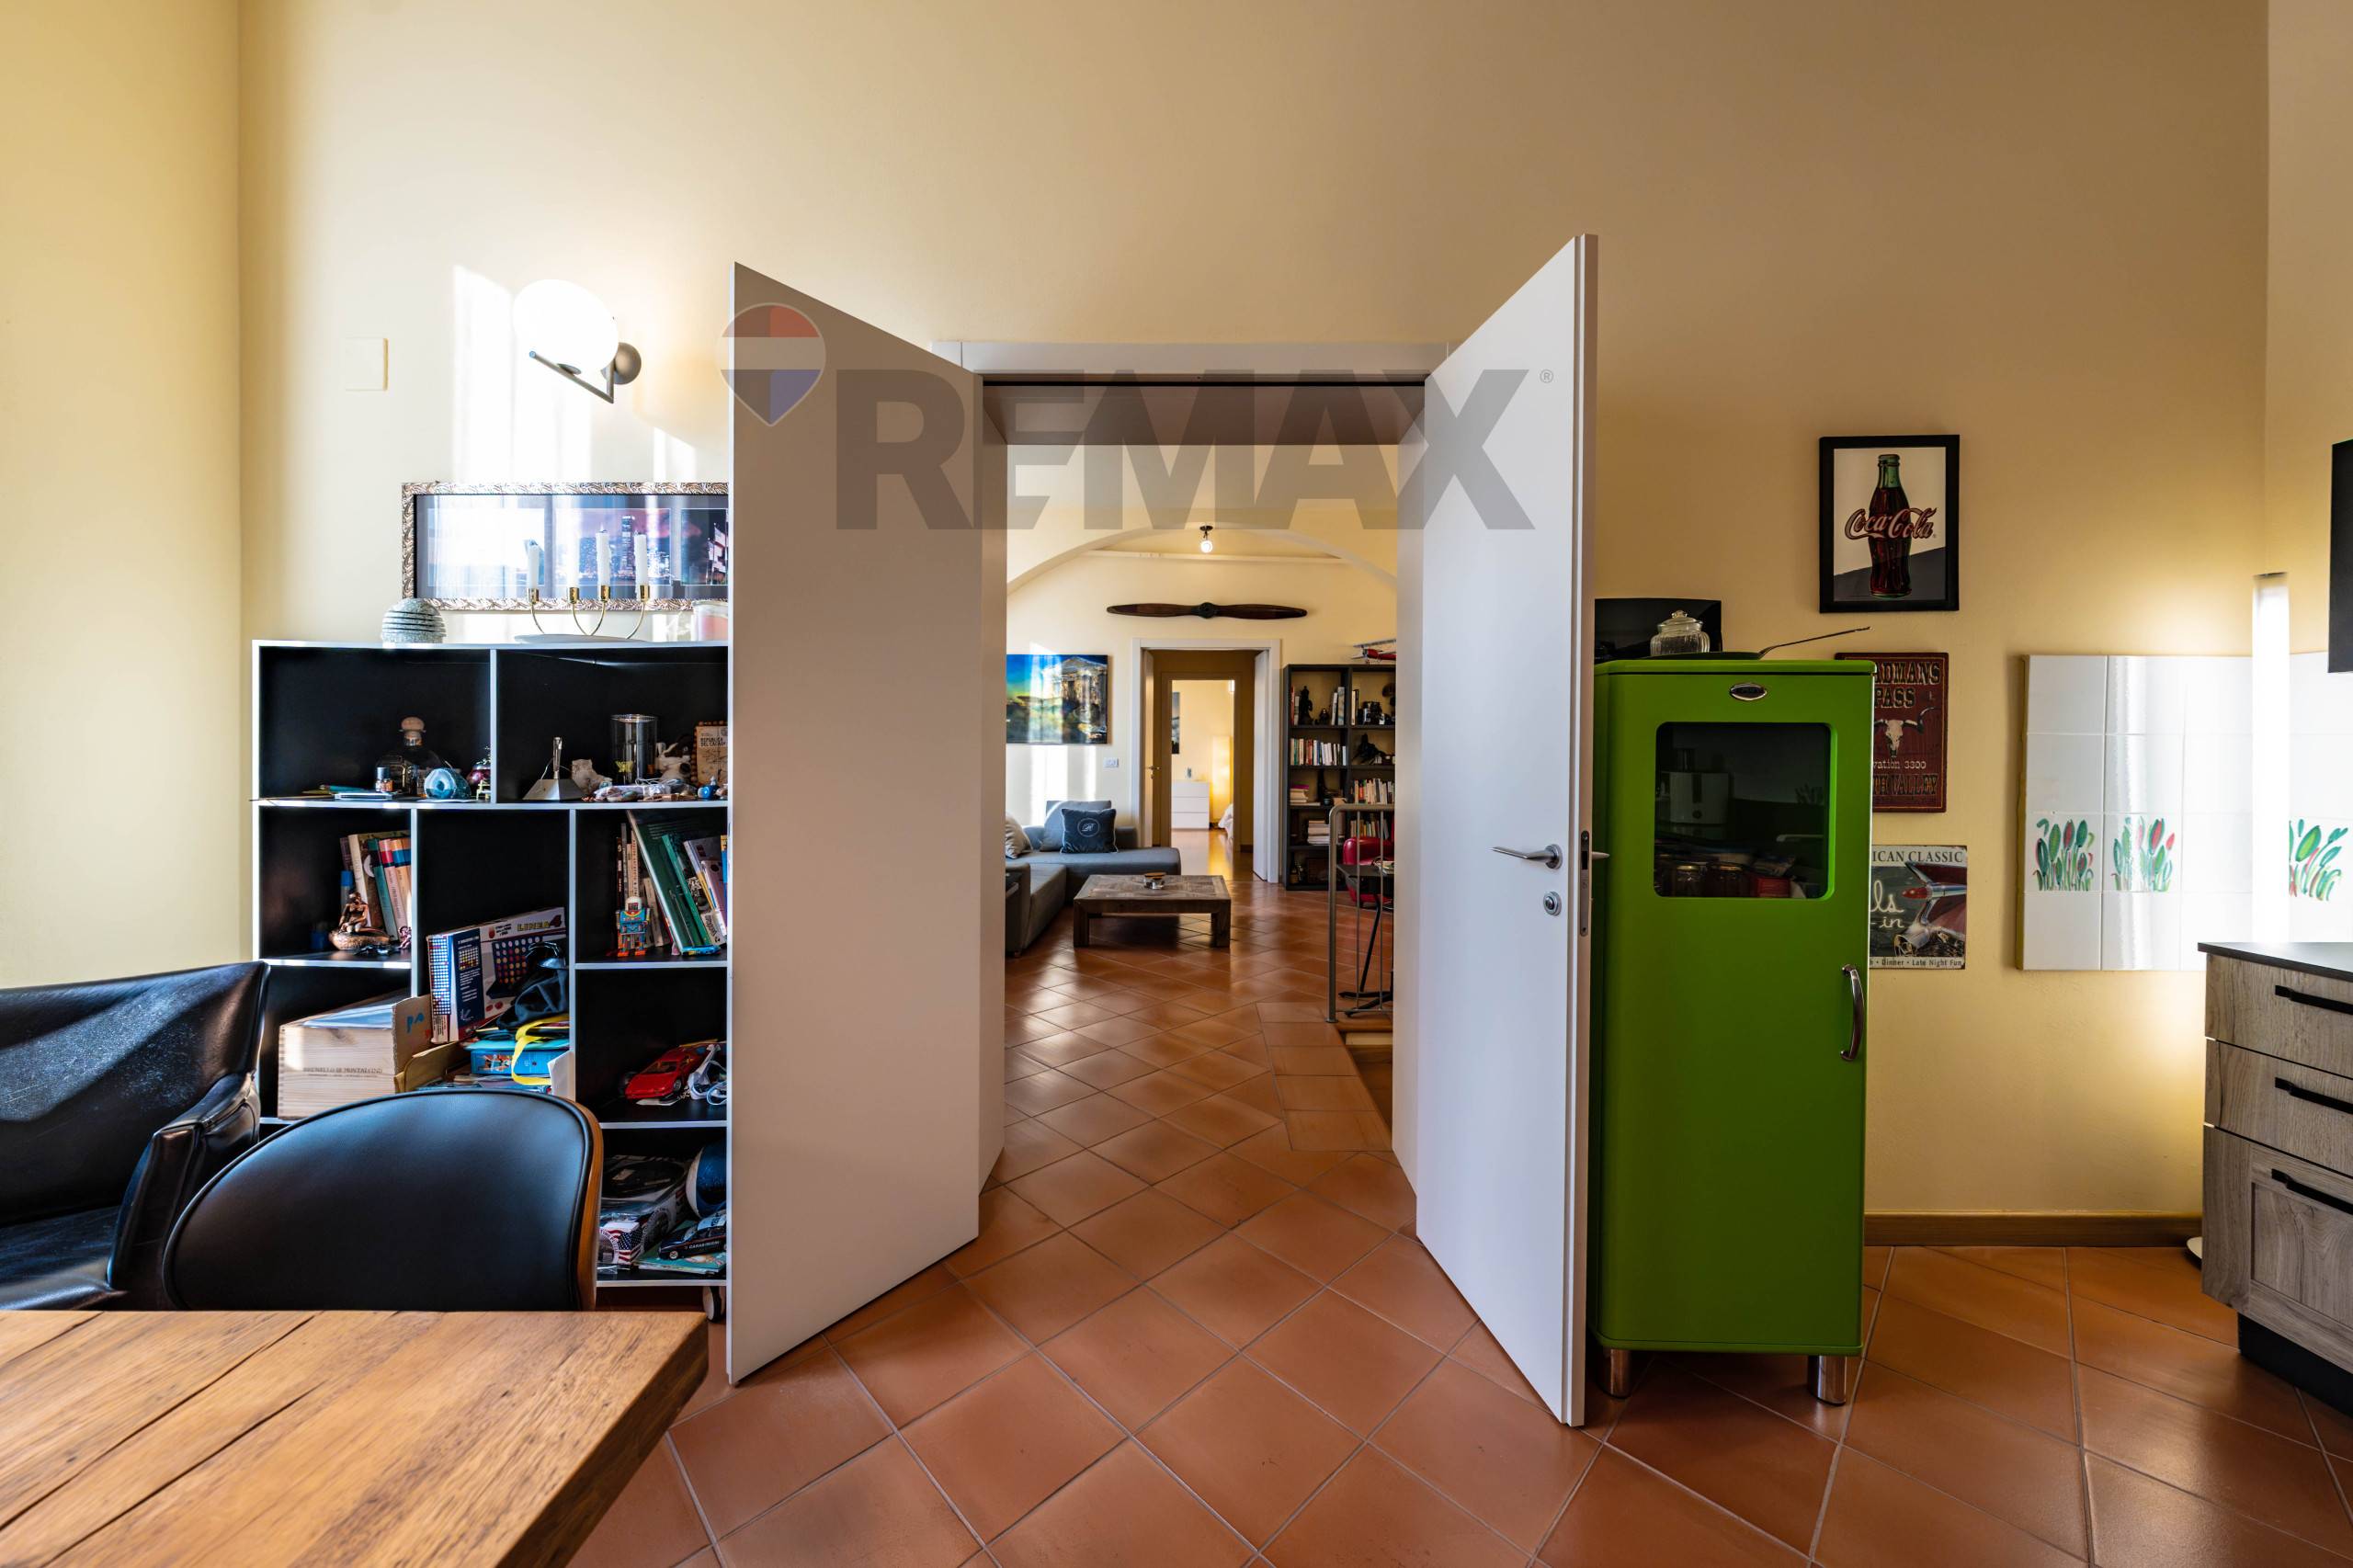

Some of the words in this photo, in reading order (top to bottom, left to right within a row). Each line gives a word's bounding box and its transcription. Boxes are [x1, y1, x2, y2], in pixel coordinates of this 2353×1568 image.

[1875, 662, 1941, 685] ADMANS
[1874, 687, 1915, 709] PASS
[1872, 758, 1900, 769] vation
[1904, 760, 1927, 769] 3300
[1891, 774, 1938, 796] VALLEY
[1872, 851, 1904, 863] ICAN
[1908, 851, 1963, 863] CLASSIC
[1881, 958, 1904, 966] Dinner
[1930, 959, 1948, 967] Night
